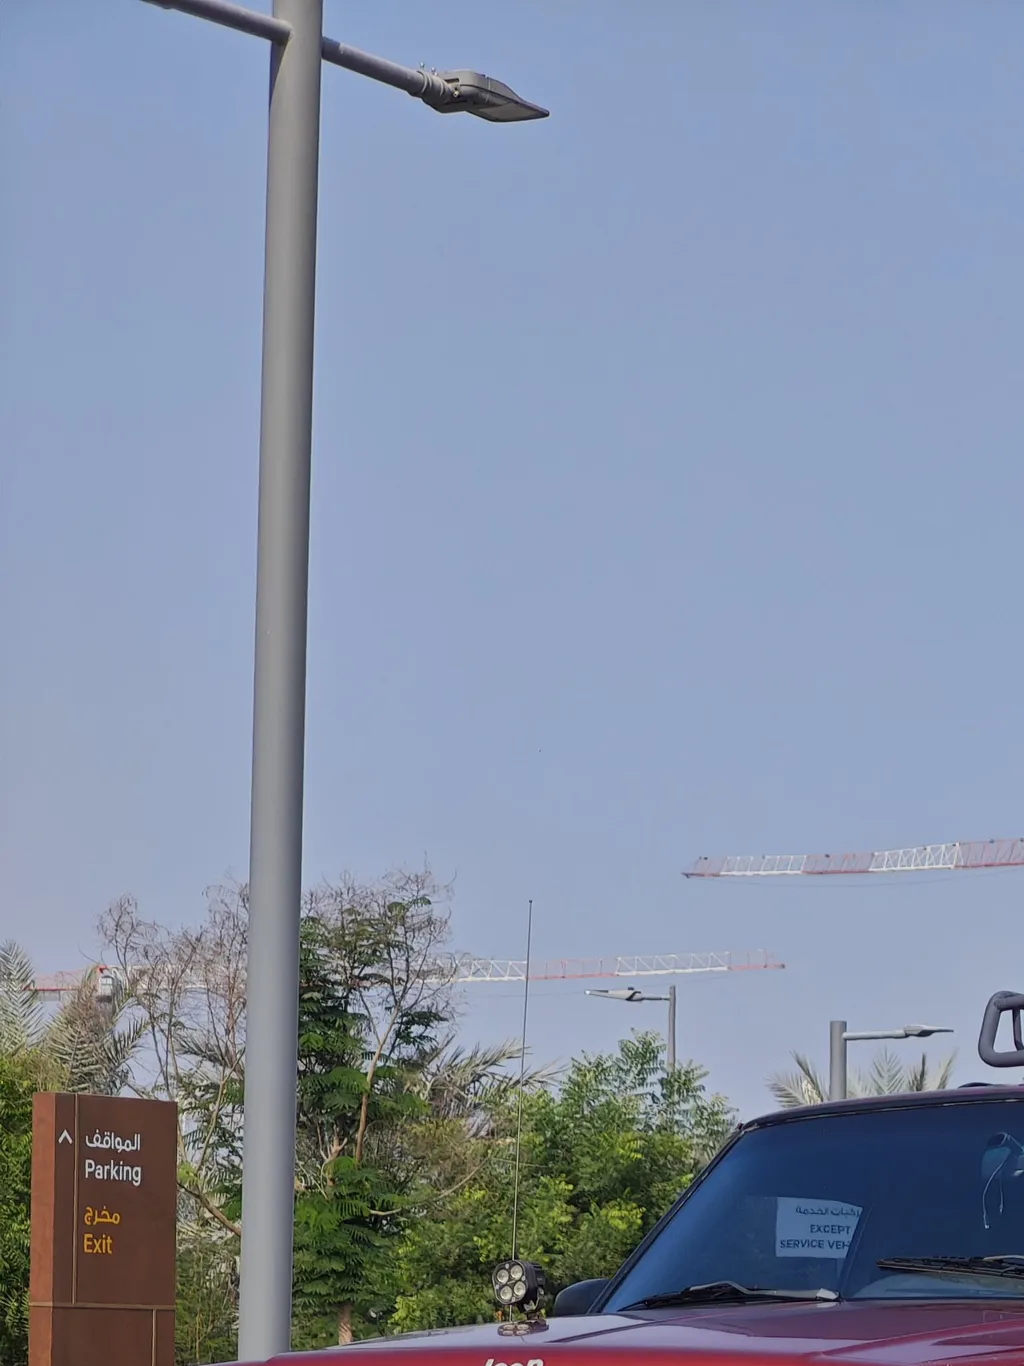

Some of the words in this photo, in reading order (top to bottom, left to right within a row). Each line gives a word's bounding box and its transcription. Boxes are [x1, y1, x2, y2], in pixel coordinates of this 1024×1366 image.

[85, 1128, 141, 1152] المواقف
[85, 1159, 142, 1187] Parking
[84, 1206, 121, 1225] مخرج
[810, 1224, 851, 1235] EXCEPT
[83, 1233, 113, 1255] Exit
[780, 1239, 824, 1249] SERVICE
